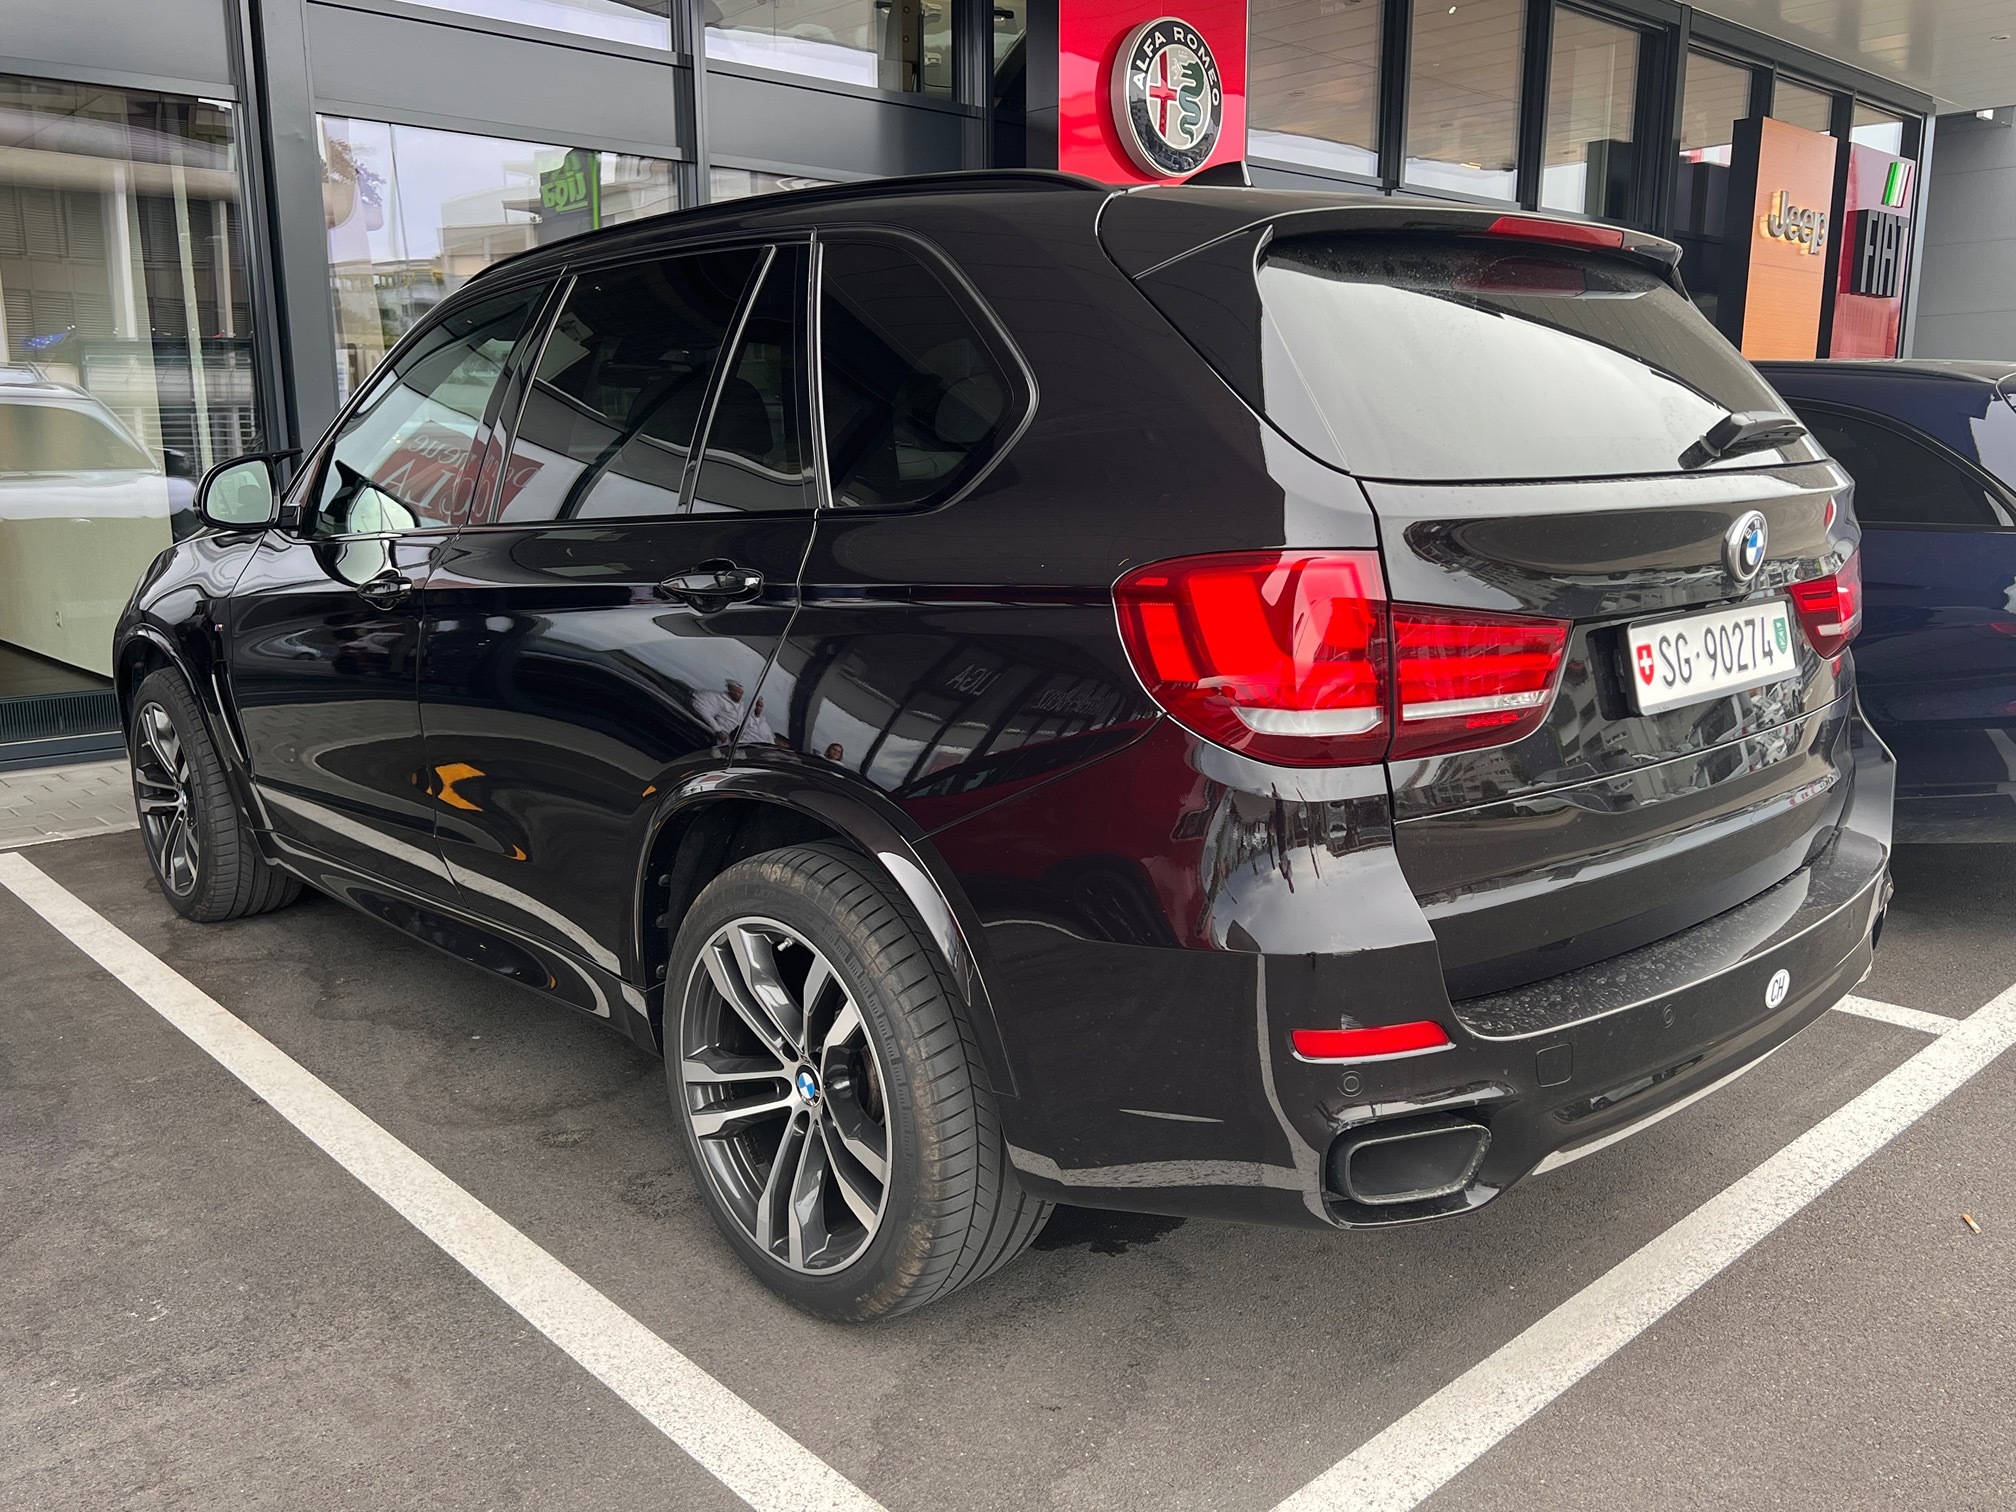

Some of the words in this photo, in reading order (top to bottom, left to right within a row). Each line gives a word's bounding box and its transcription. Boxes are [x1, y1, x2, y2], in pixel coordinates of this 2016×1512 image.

[1133, 31, 1167, 91] ALFA
[1173, 27, 1220, 106] ROMEO
[1768, 190, 1828, 255] Jeep
[1860, 209, 1910, 298] FIAT
[1770, 975, 1786, 1003] CH
